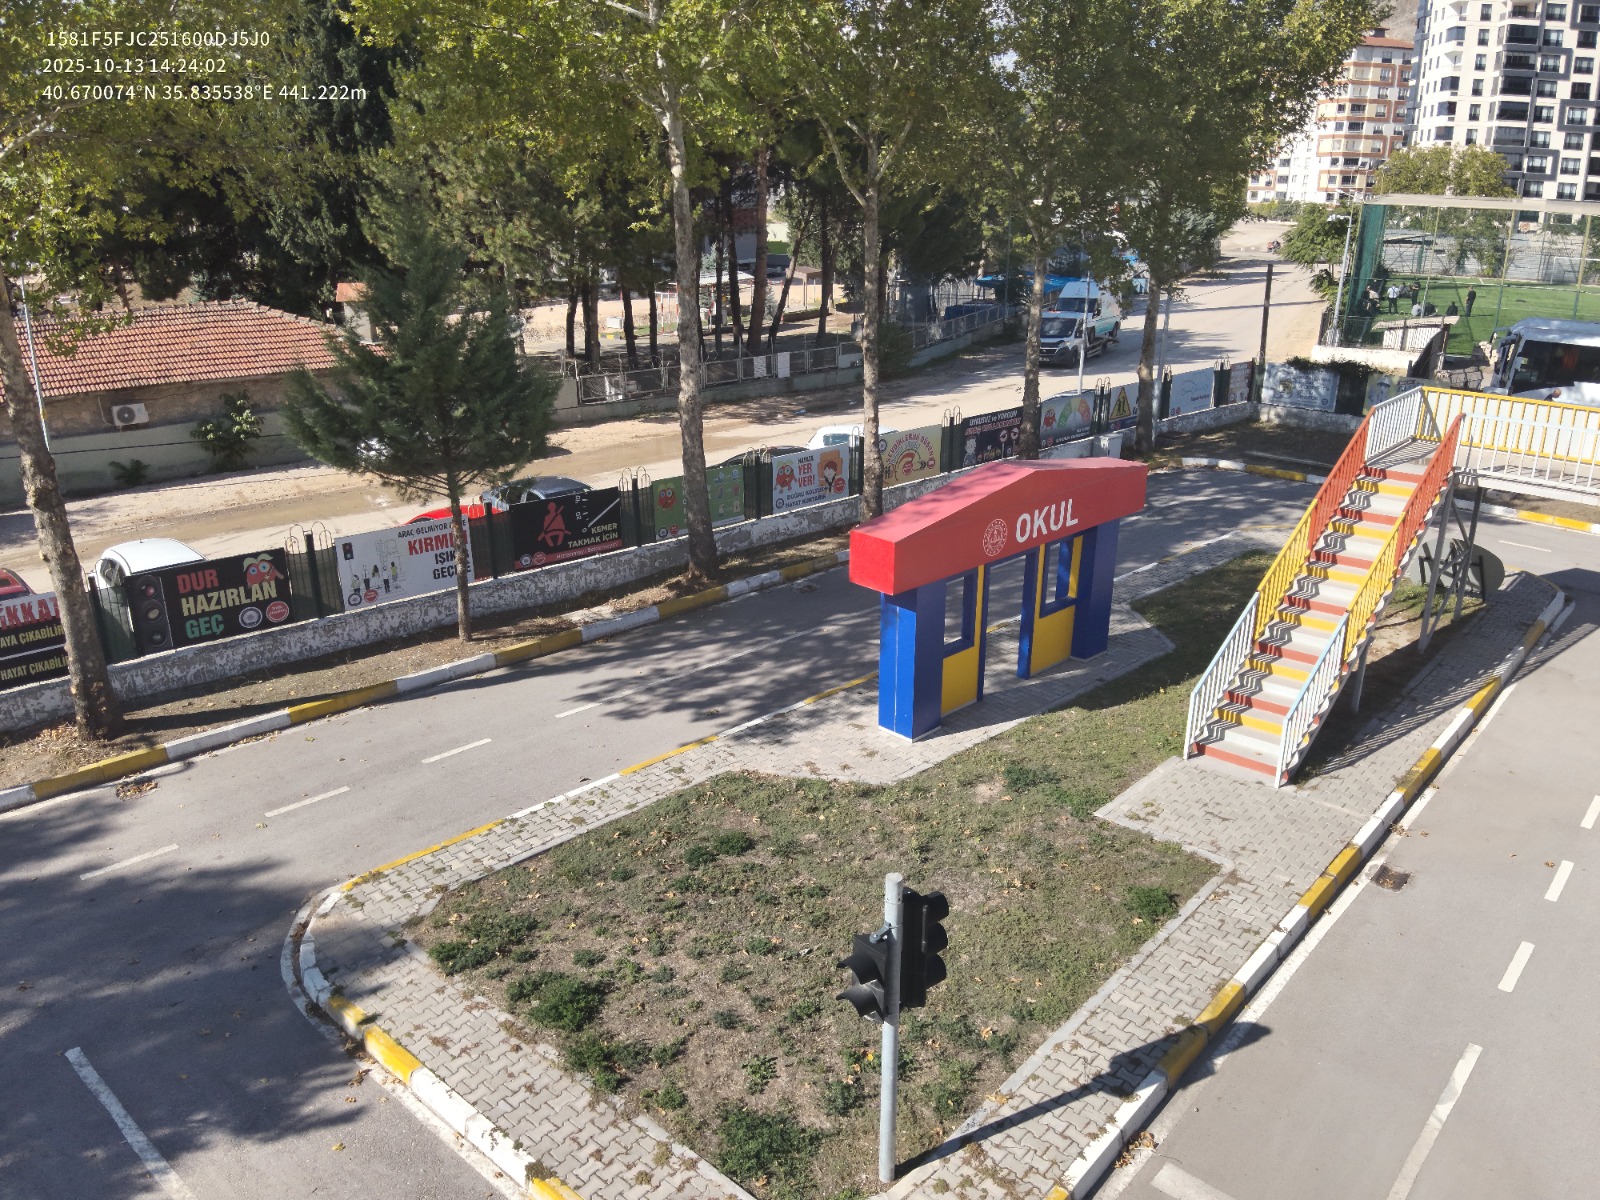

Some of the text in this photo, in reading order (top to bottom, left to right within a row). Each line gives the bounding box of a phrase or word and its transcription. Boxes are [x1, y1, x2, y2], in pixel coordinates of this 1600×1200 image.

[798, 463, 813, 475] YER
[798, 474, 815, 488] VER!
[591, 522, 618, 535] KEMER
[1015, 498, 1079, 543] OKUL
[397, 530, 415, 539] ARAÇ
[415, 522, 448, 535] GELMİYOR
[407, 529, 468, 556] KIRMII
[567, 531, 619, 549] TAKMAK İÇİN
[176, 568, 220, 594] DUR
[432, 565, 472, 580] GEÇE
[180, 580, 278, 617] HAZIRLAN
[185, 614, 225, 640] GEÇ
[0, 665, 28, 681] HAYAT
